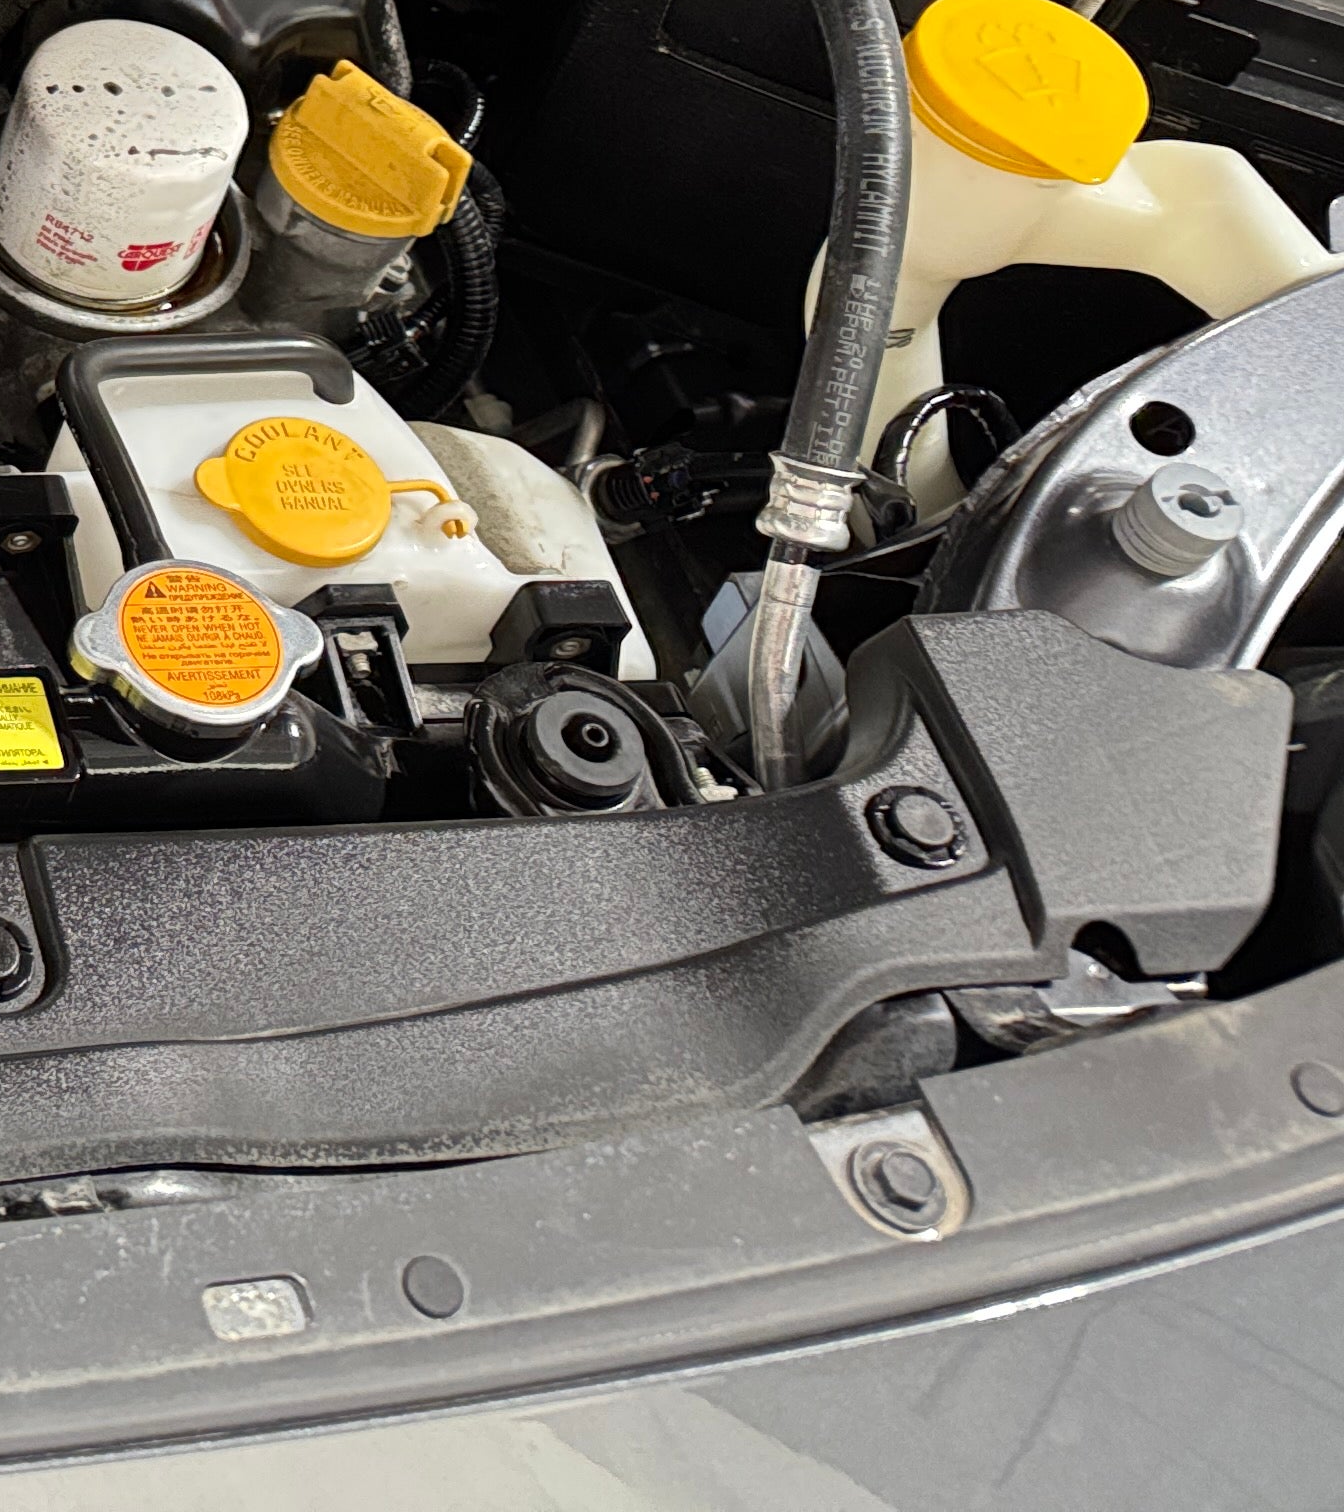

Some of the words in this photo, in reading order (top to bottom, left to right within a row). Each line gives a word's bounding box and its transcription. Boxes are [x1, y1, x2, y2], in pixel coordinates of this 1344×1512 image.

[234, 421, 366, 464] COOLANT
[280, 495, 350, 512] MANUAL
[165, 583, 227, 593] WARNING
[133, 624, 168, 633] NEVER
[172, 624, 200, 633] OPEN
[202, 623, 235, 632] WHEN
[239, 622, 260, 630] HOT
[136, 634, 146, 642] NE
[152, 634, 184, 642] JAMAIS
[187, 633, 221, 642] OUVRIR
[167, 669, 261, 681] AVERTISSEMENT
